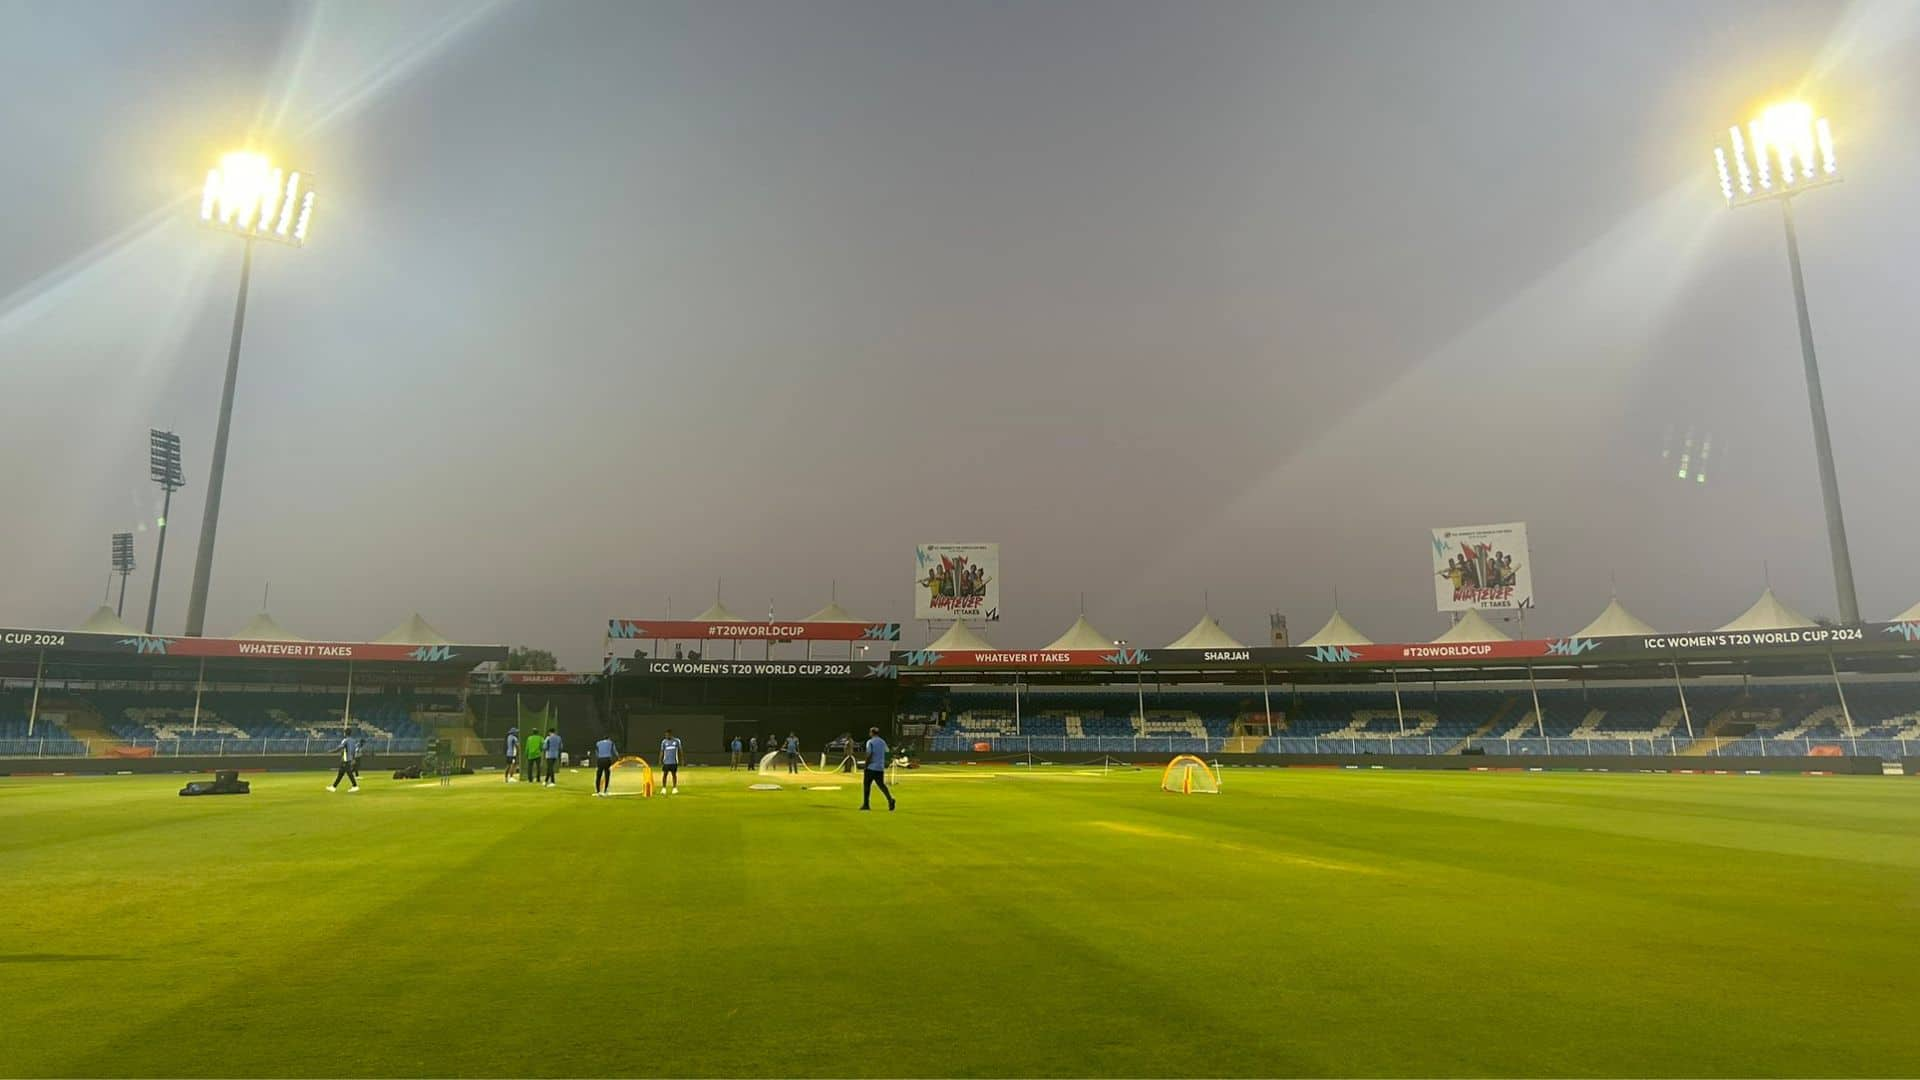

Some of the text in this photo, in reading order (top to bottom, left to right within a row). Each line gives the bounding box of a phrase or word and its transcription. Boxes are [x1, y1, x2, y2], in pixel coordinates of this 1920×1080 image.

[1453, 587, 1514, 603] WHATEVER
[930, 595, 984, 611] WHATEVER
[708, 626, 805, 636] #T20WORLDCUP
[5, 633, 32, 644] CUP
[34, 634, 65, 645] 2024
[1644, 629, 1863, 649] ICC WOMEN'S T20 WORLD CUP 2024
[239, 644, 352, 656] WHATEVER IT TAKES
[1204, 651, 1250, 661] SHARJAH
[1403, 645, 1491, 657] #T20WORLDCUP
[975, 653, 1070, 662] WHATEVER IT TAKES
[649, 663, 851, 674] ICC WOMEN'S T20 WORLD CUP 2024
